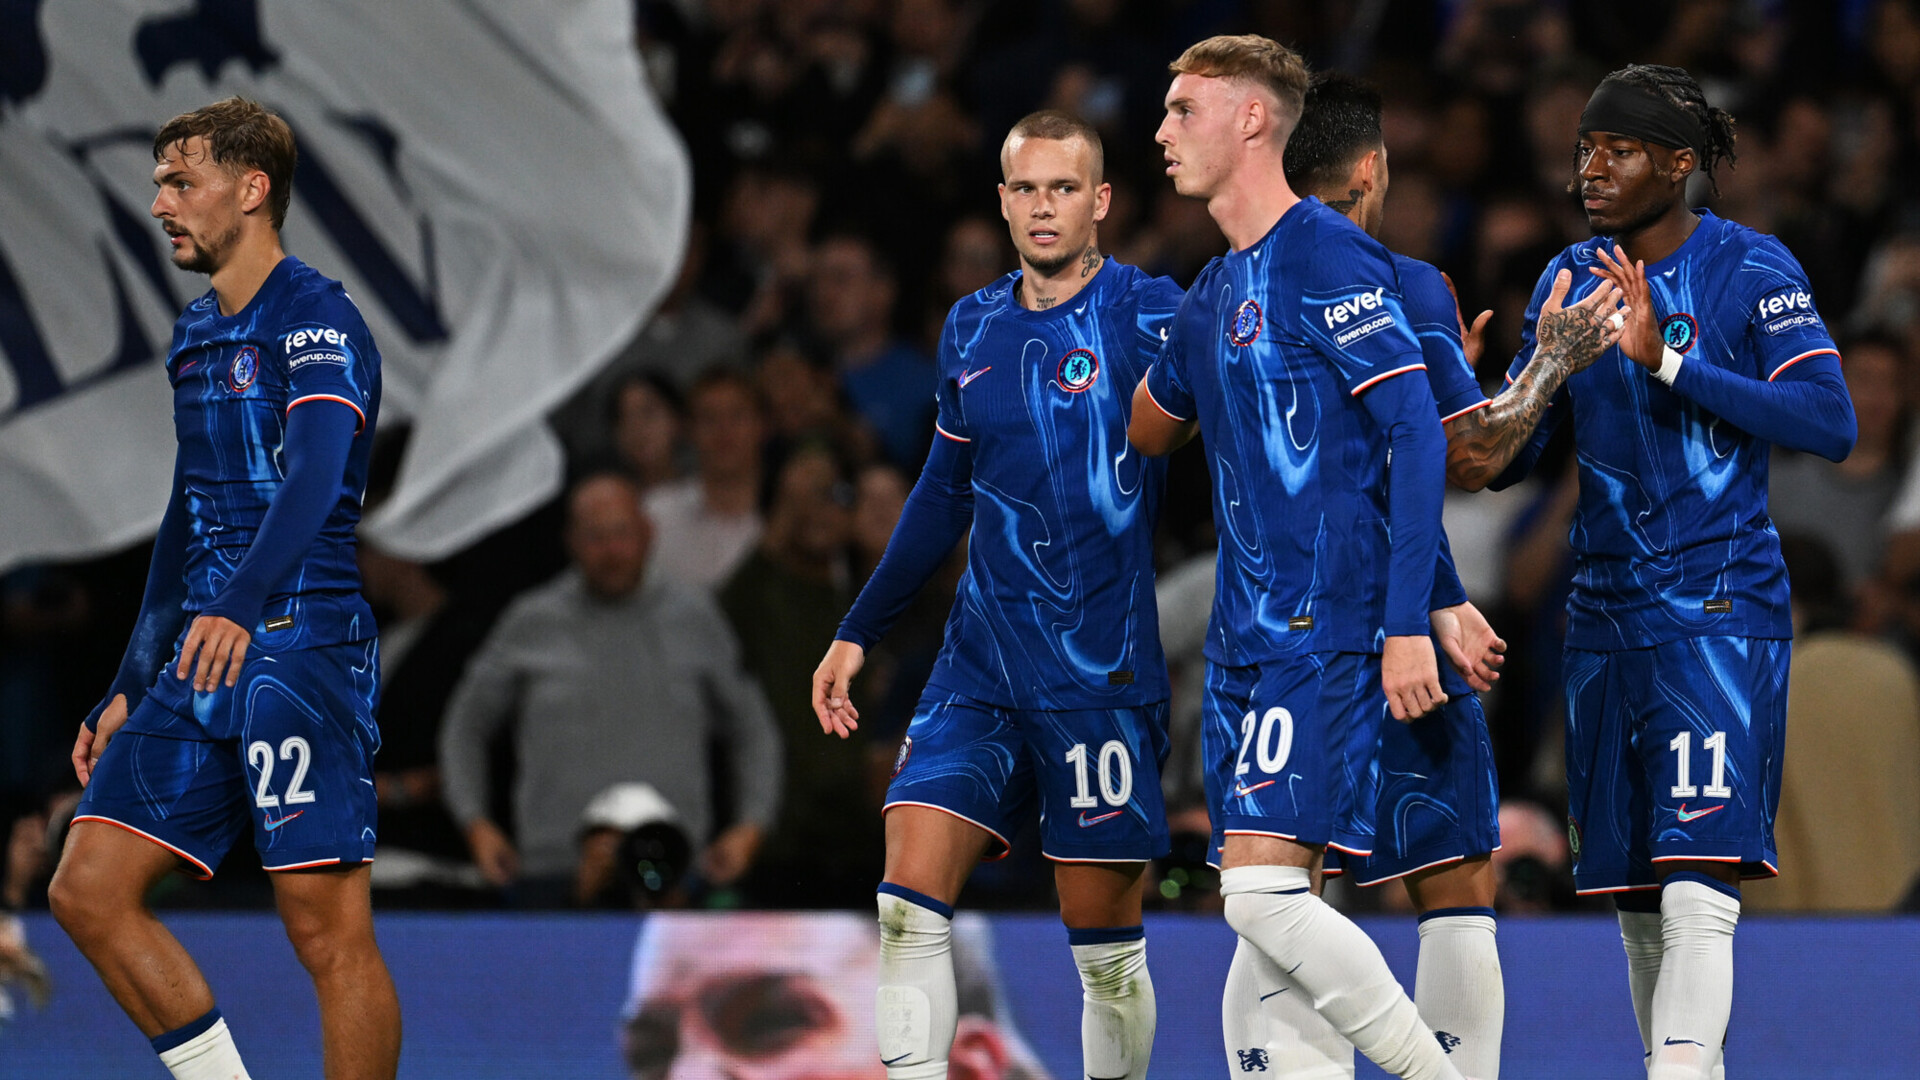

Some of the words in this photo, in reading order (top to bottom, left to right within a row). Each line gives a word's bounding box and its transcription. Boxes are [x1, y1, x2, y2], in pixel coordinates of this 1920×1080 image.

[1324, 287, 1384, 330] fever
[1759, 292, 1811, 319] fever
[285, 328, 348, 354] fever
[1337, 316, 1393, 345] feverup.com
[289, 353, 347, 369] feverup.com
[1234, 706, 1294, 776] 20
[247, 735, 316, 808] 22
[1065, 739, 1133, 808] 10
[1669, 731, 1732, 799] 11
